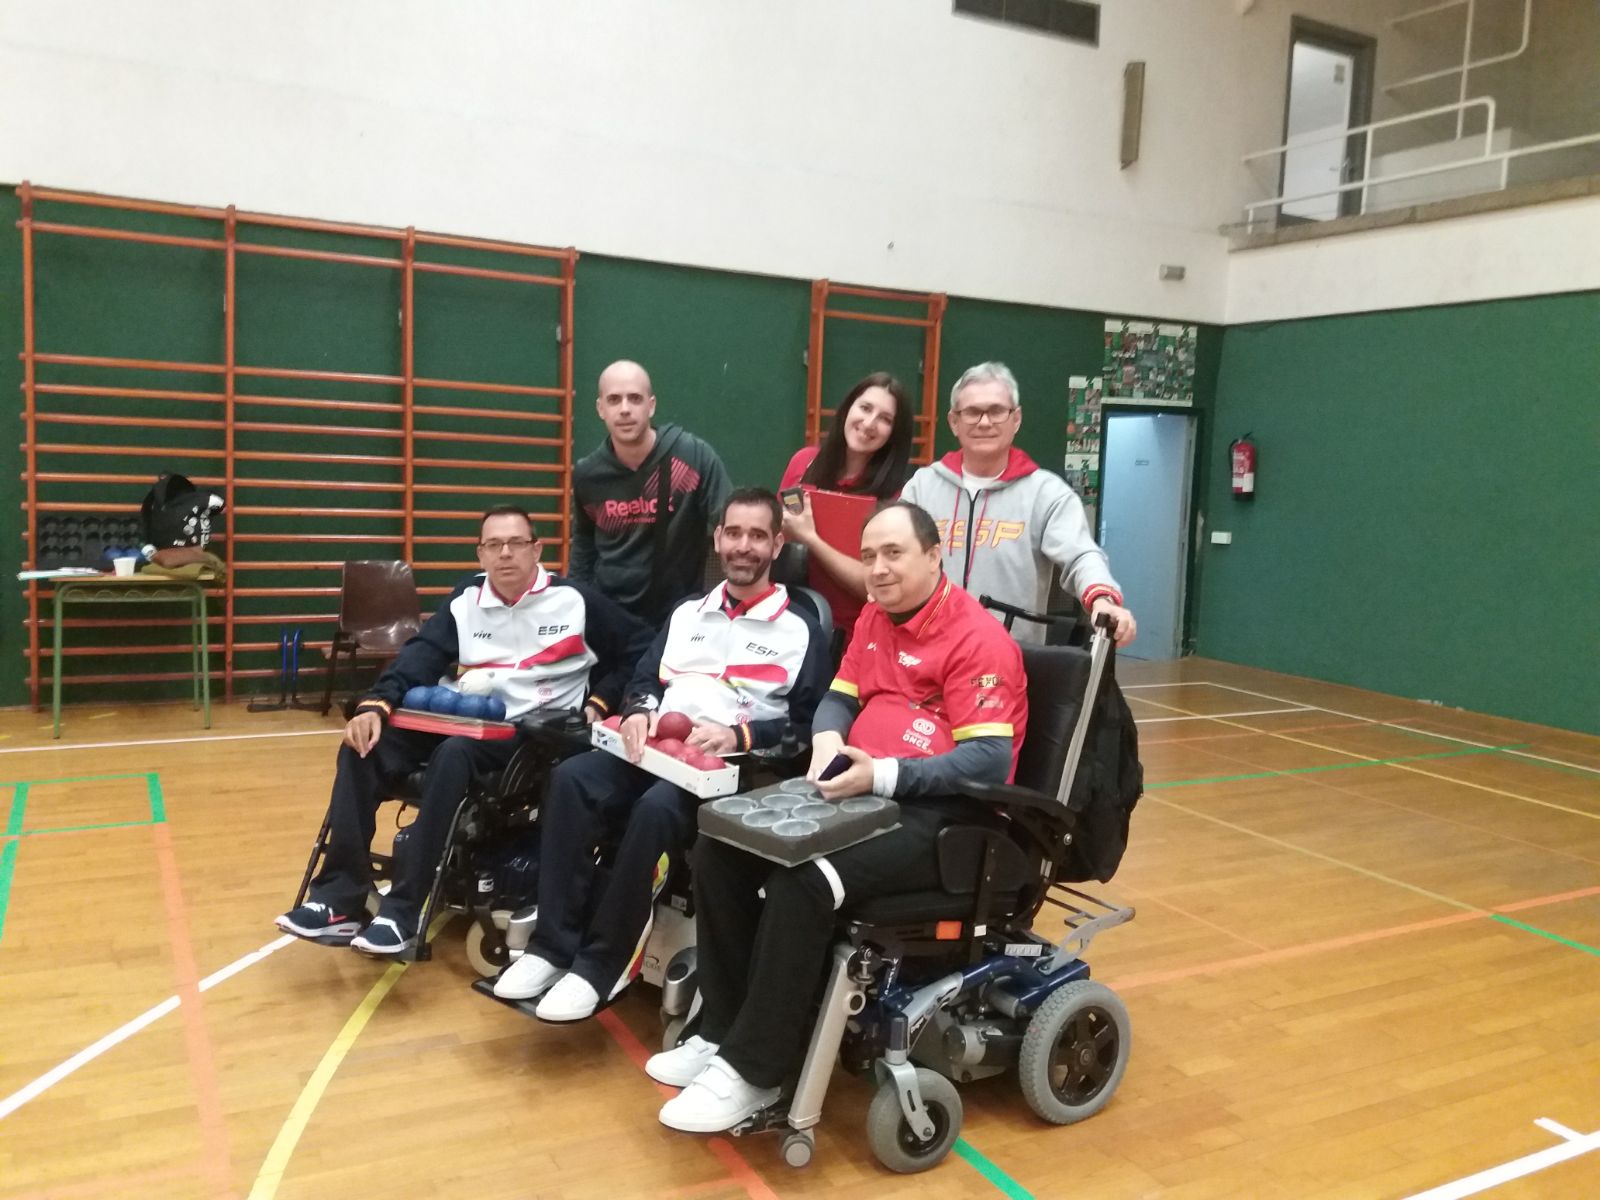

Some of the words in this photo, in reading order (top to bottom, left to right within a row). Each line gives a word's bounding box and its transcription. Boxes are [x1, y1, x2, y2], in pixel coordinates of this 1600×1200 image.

[538, 624, 570, 636] ESP
[745, 642, 779, 658] ESP
[902, 733, 929, 750] ONCE
